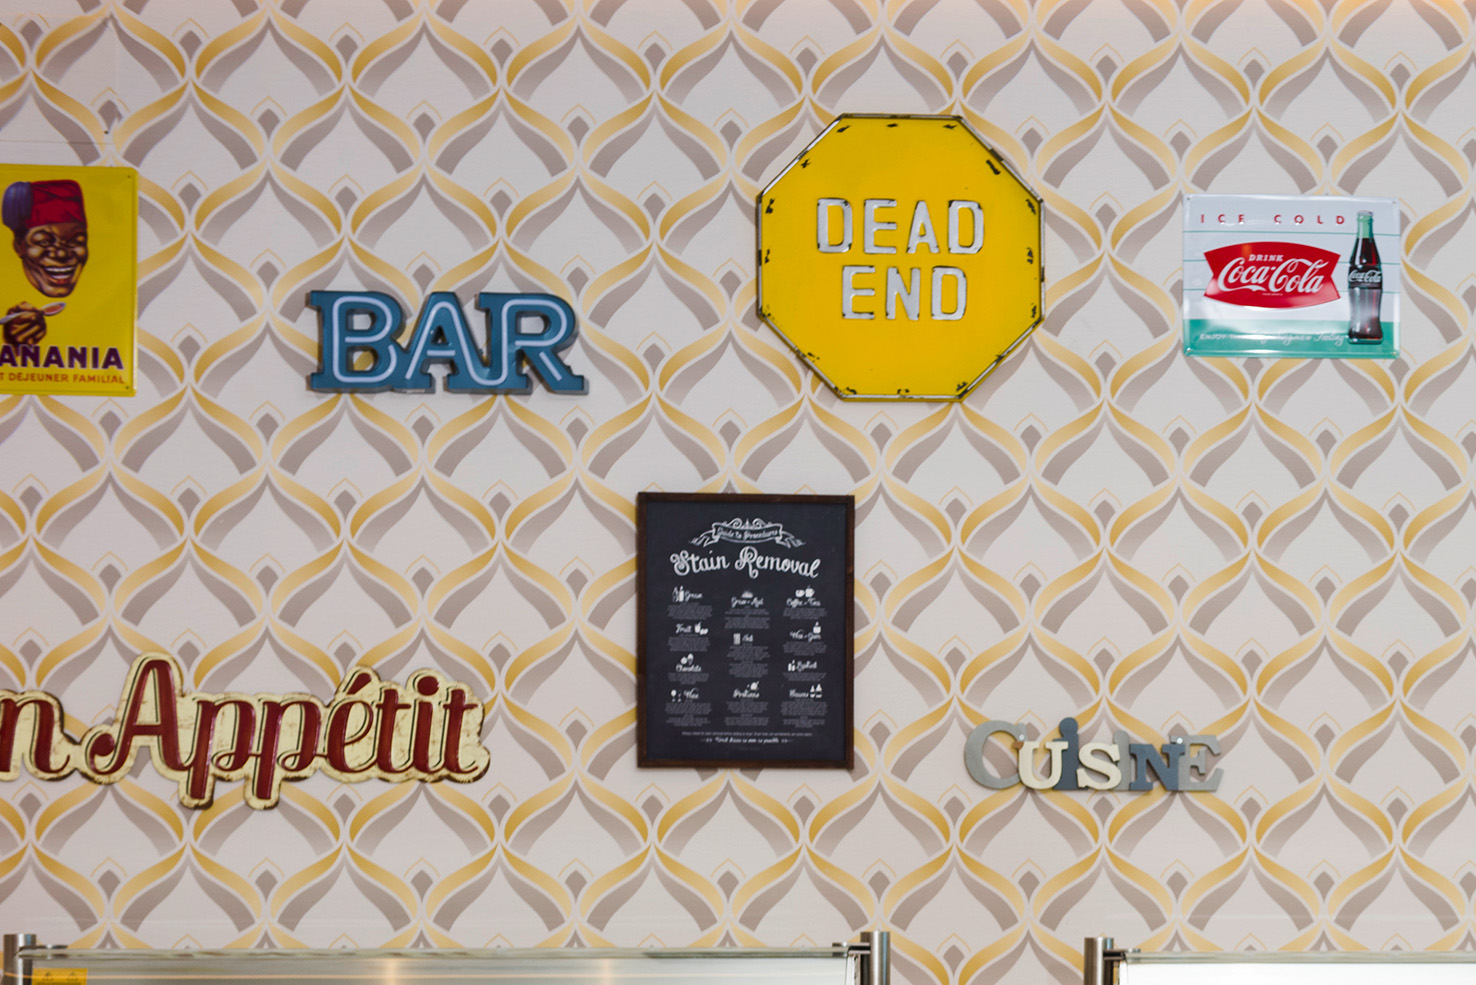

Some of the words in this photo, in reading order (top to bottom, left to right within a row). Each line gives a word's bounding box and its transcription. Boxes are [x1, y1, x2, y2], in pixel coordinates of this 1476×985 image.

[816, 197, 984, 254] DEAD
[1200, 214, 1246, 225] ICE
[1273, 214, 1345, 225] COLD
[1217, 256, 1329, 293] Coca-Cola
[1248, 254, 1284, 262] DRINK
[842, 265, 967, 321] END
[0, 344, 125, 371] ANANIA
[307, 290, 588, 394] BAR
[72, 374, 125, 384] FAMILIAL
[669, 550, 730, 577] Stain
[734, 545, 821, 579] Removal
[86, 655, 485, 806] Appétit
